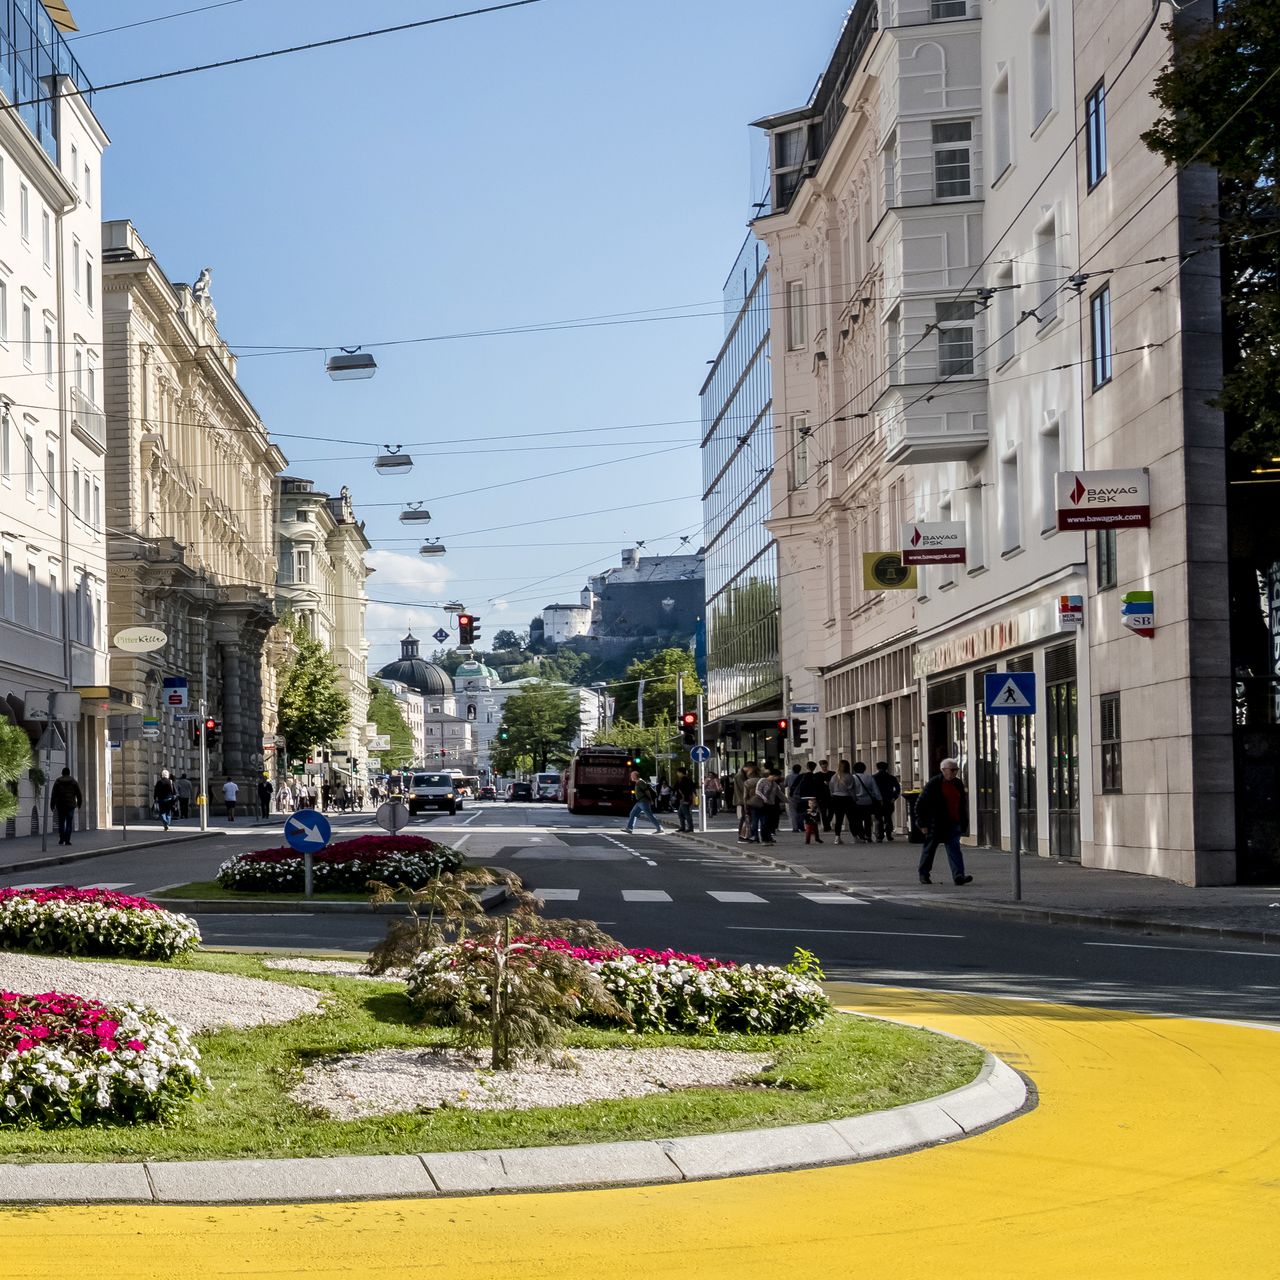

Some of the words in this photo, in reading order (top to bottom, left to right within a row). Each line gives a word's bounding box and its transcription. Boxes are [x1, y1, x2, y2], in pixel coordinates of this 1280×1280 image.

[1087, 486, 1138, 496] BAWAG
[1087, 496, 1117, 504] PSK
[1067, 513, 1142, 524] www.bawagpsk.com
[1133, 616, 1151, 626] SB
